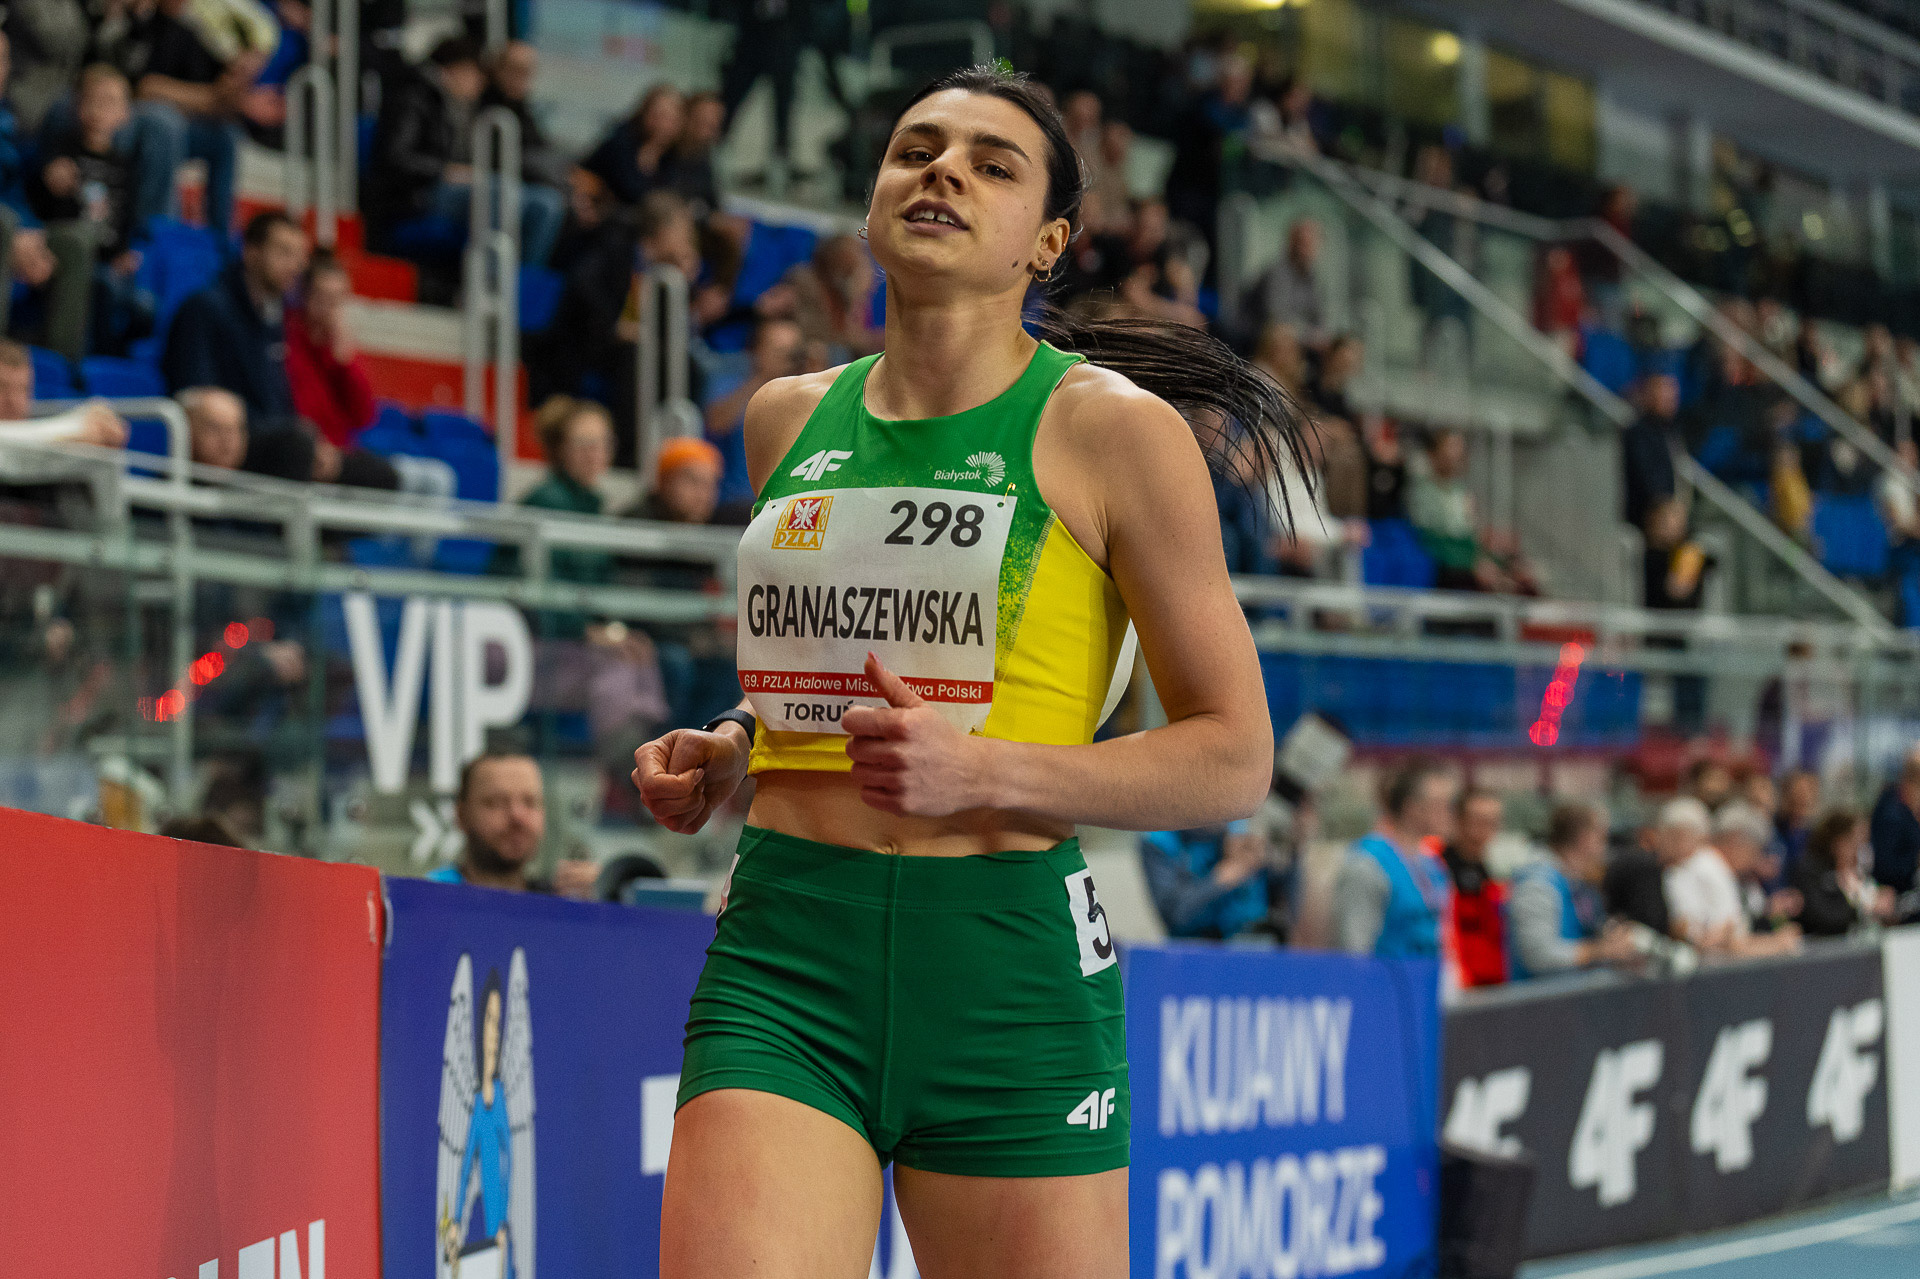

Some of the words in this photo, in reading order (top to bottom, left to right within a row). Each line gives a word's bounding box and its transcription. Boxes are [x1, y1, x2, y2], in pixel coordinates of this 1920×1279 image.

[790, 450, 854, 481] 4F
[934, 469, 982, 482] Białystok
[775, 531, 820, 547] PZLA
[884, 500, 985, 548] 298
[747, 584, 984, 646] GRANASZEWSKA
[342, 592, 535, 793] VIP
[744, 674, 760, 689] 69.
[762, 676, 791, 690] PZLA
[794, 676, 842, 691] Halowe
[938, 683, 982, 699] Polski
[1083, 876, 1112, 960] 5
[1159, 996, 1351, 1138] KUJAWY
[1690, 1018, 1774, 1174] 4F
[1806, 998, 1883, 1144] 4F
[1066, 1087, 1116, 1130] 4F
[1569, 1038, 1664, 1208] 4F
[1156, 1144, 1386, 1279] POMORZE
